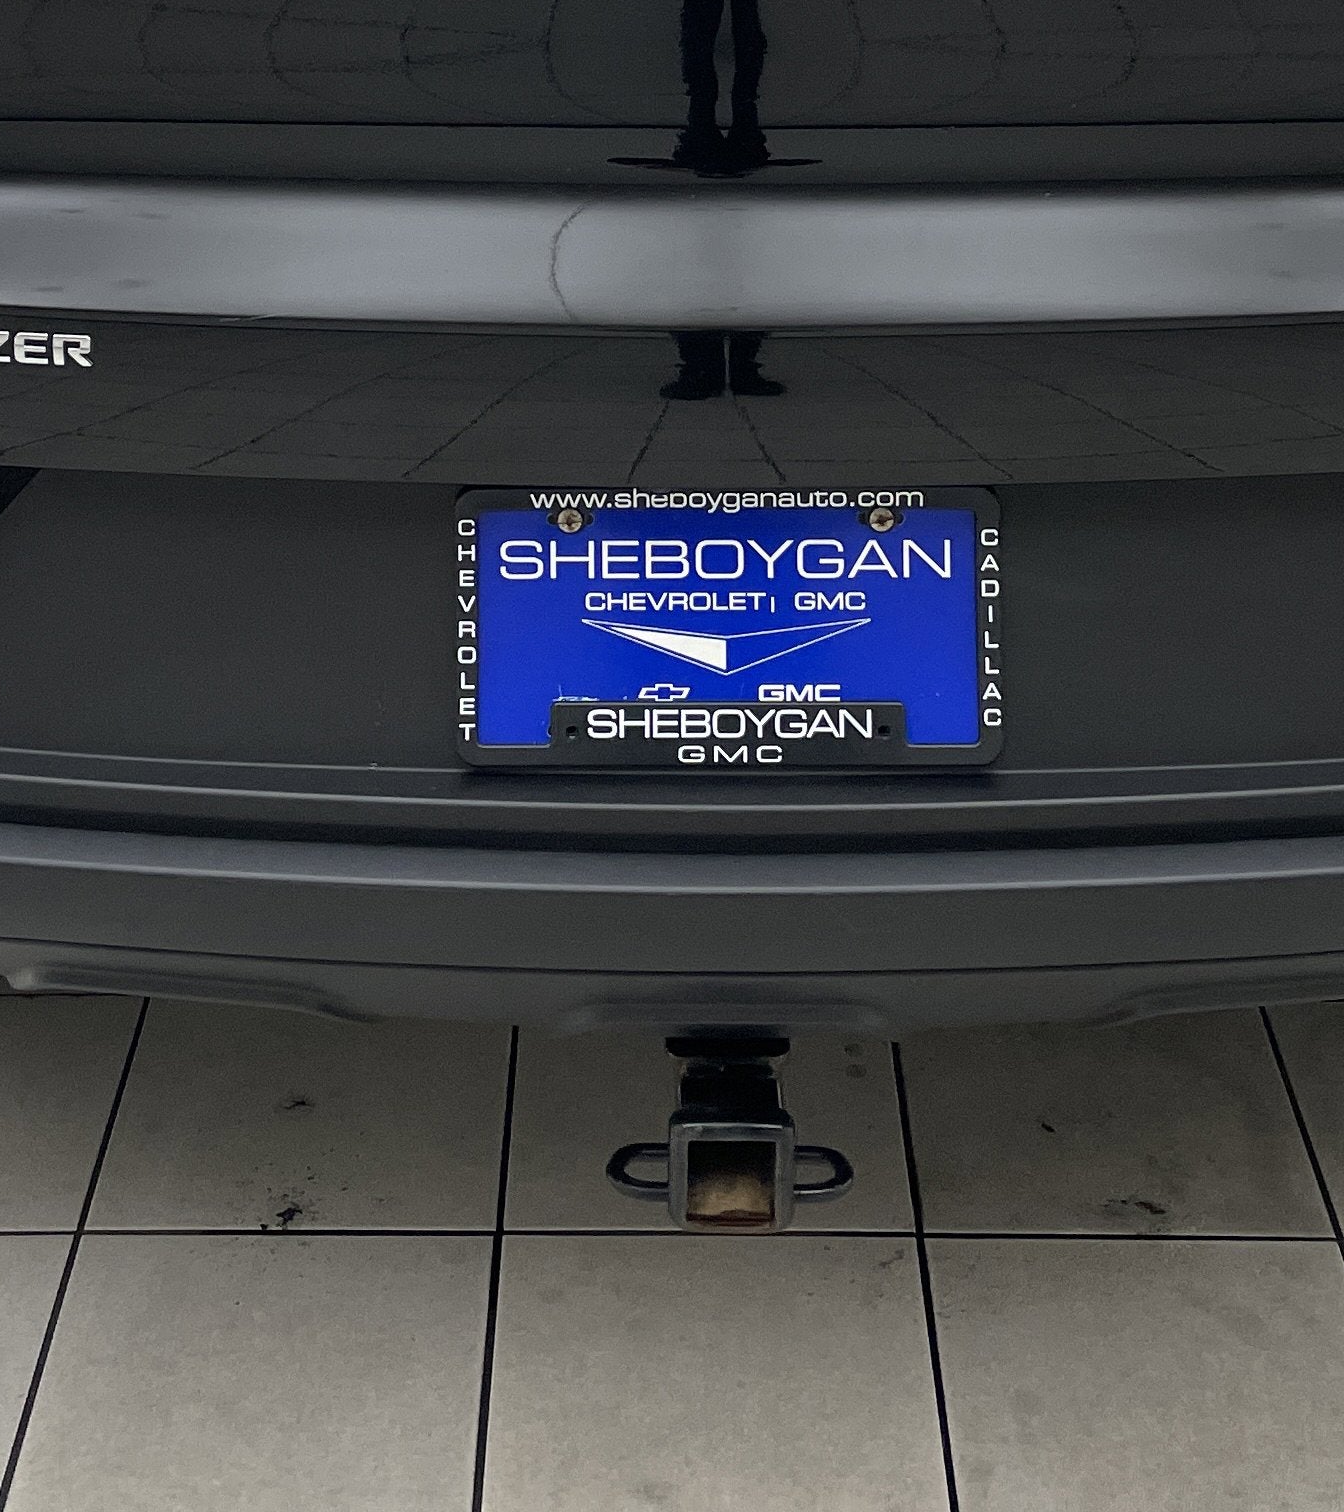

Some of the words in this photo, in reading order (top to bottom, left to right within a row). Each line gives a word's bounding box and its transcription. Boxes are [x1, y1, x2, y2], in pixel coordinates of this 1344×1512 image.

[529, 487, 925, 514] www.sheboyganauto.com
[499, 539, 953, 580] SHEBOYGAN
[584, 592, 767, 611] CHEVROLET
[794, 591, 867, 611] GMC
[457, 519, 478, 742] CHEVROLET
[980, 528, 1003, 727] CADILLAC
[758, 684, 842, 702] GMC
[587, 708, 873, 739] SHEBOYGAN
[677, 745, 784, 764] GMC
